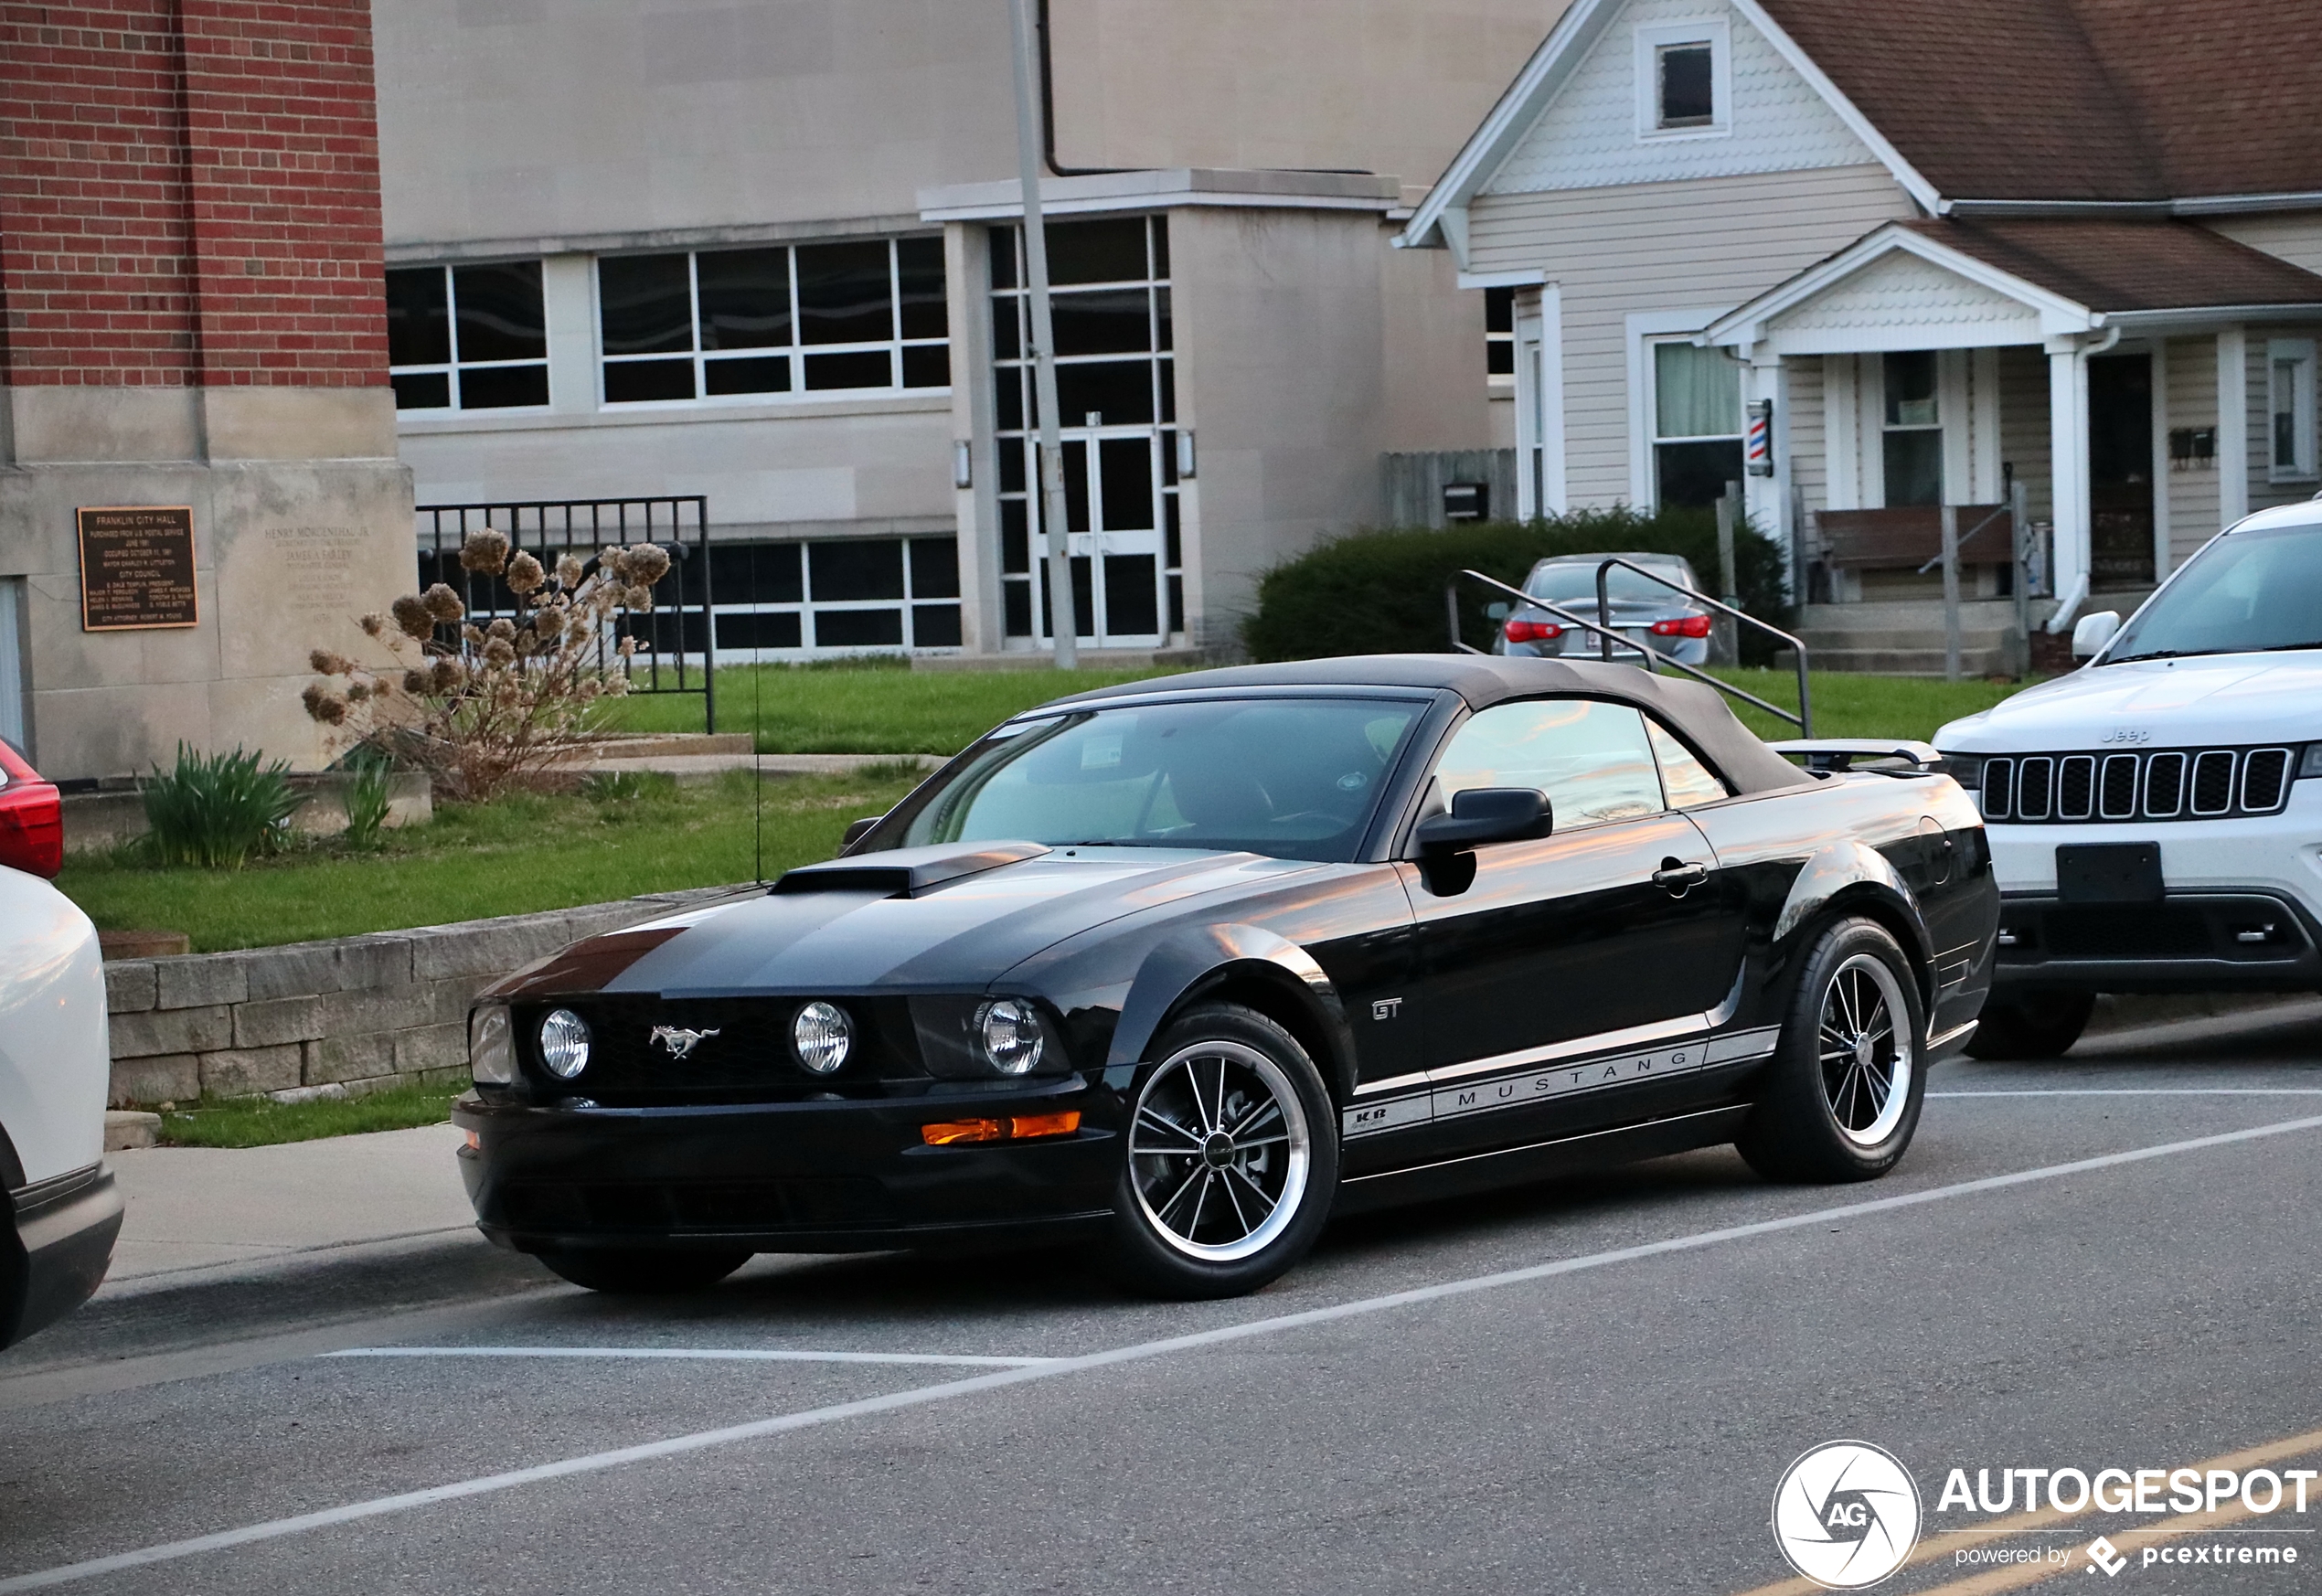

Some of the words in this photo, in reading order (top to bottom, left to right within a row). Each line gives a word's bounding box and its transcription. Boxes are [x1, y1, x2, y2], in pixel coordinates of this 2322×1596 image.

[96, 516, 133, 526] FRANKLIN
[136, 516, 154, 525] CITY
[156, 515, 176, 524] HALL
[134, 569, 161, 578] COUNCIL
[2102, 727, 2150, 744] Jeep
[1371, 997, 1402, 1020] GT
[1458, 1052, 1687, 1106] MUSTANG
